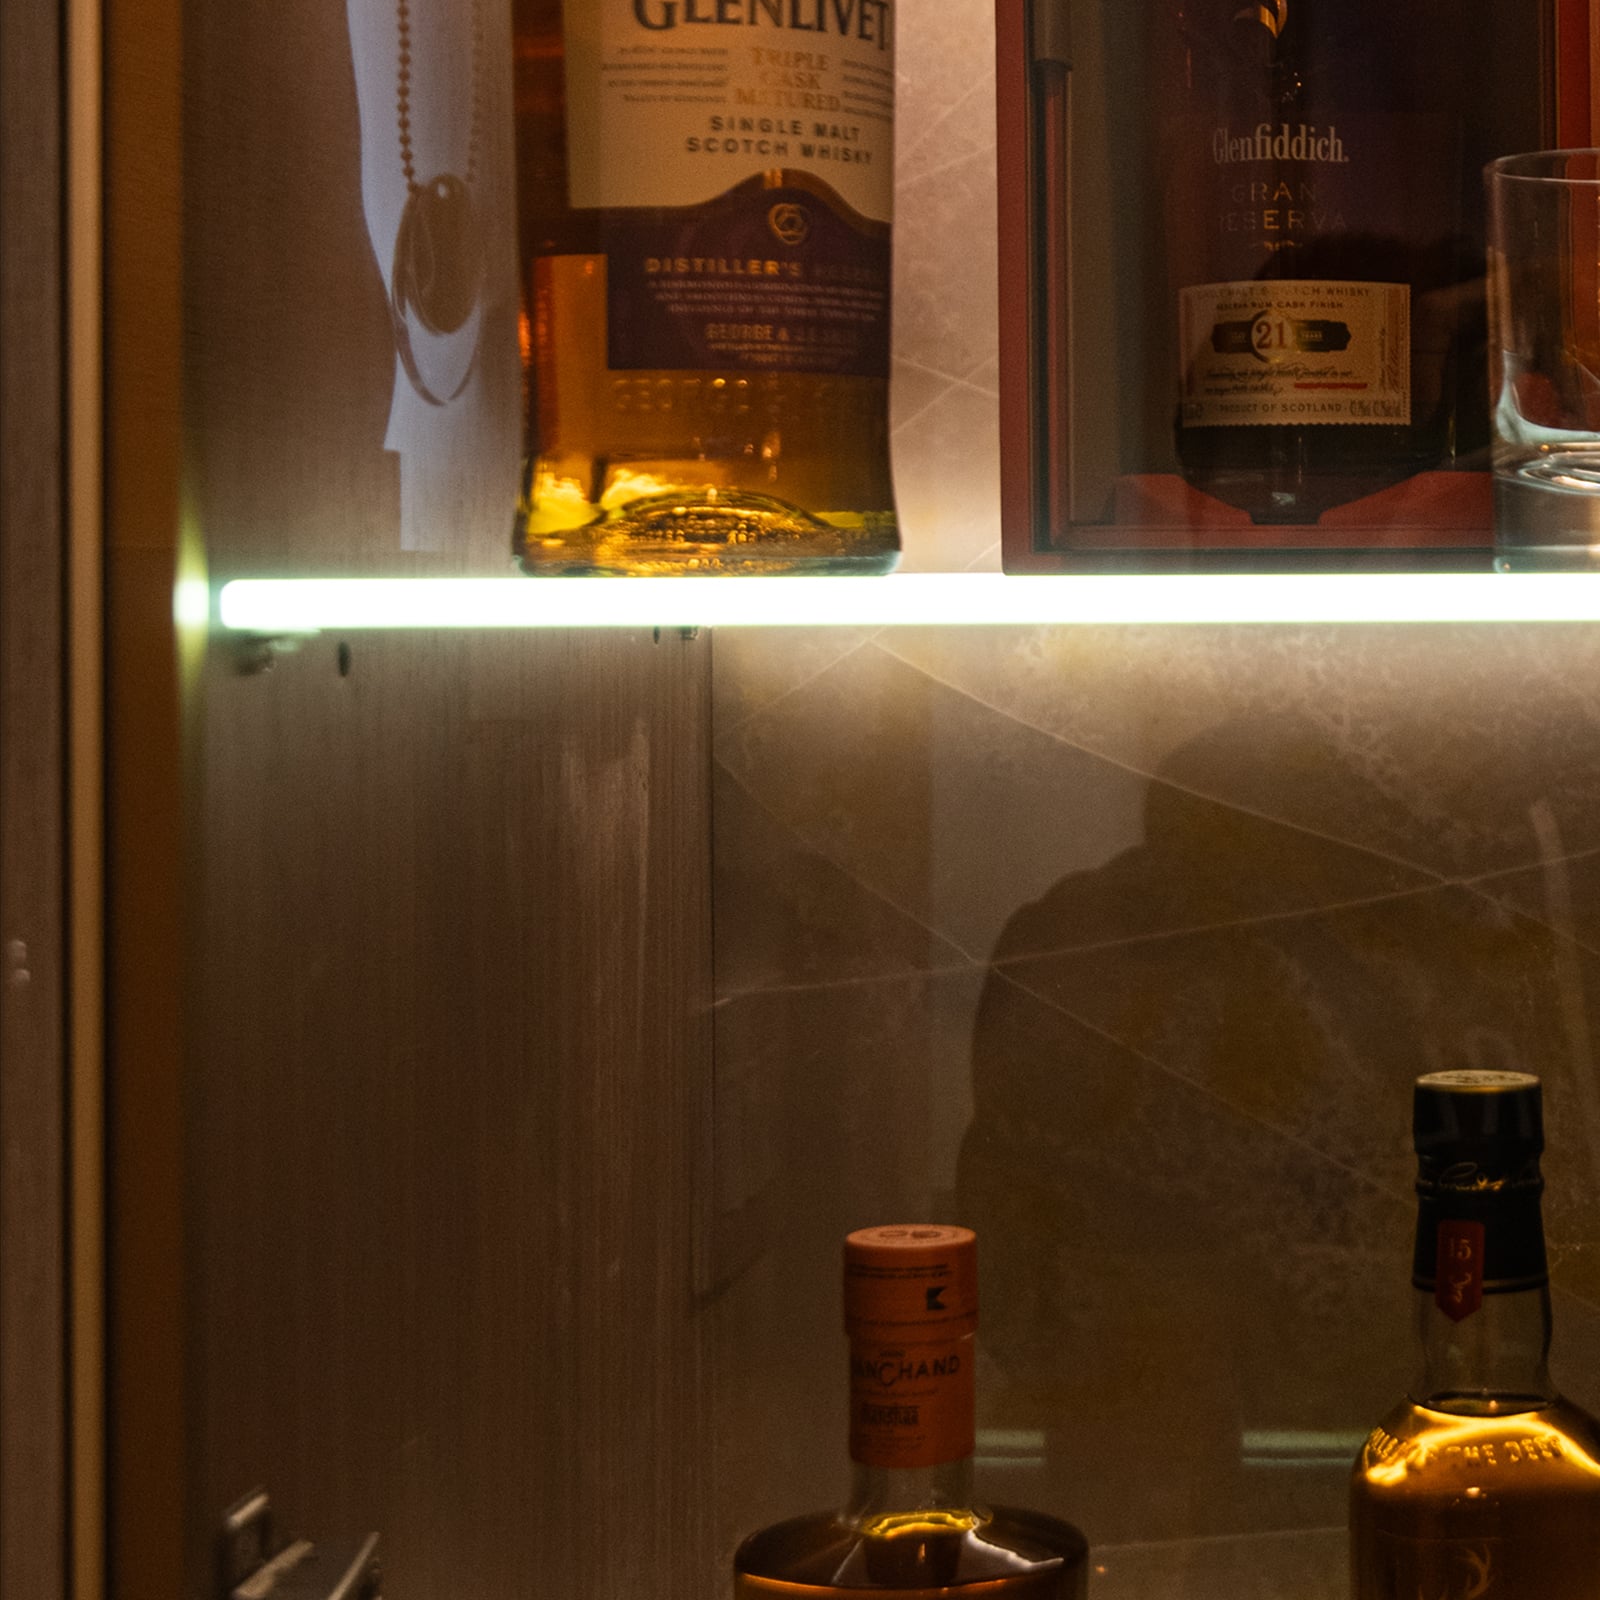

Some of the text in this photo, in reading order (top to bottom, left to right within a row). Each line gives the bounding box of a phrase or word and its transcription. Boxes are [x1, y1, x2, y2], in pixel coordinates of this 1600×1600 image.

[750, 46, 829, 72] TRIPLE
[709, 115, 861, 143] SINGLE MALT
[686, 136, 873, 165] SCOTCH WHISKY
[643, 257, 802, 277] DISTILLER'S
[1256, 321, 1287, 350] 21
[1281, 401, 1342, 413] SCOTLAND
